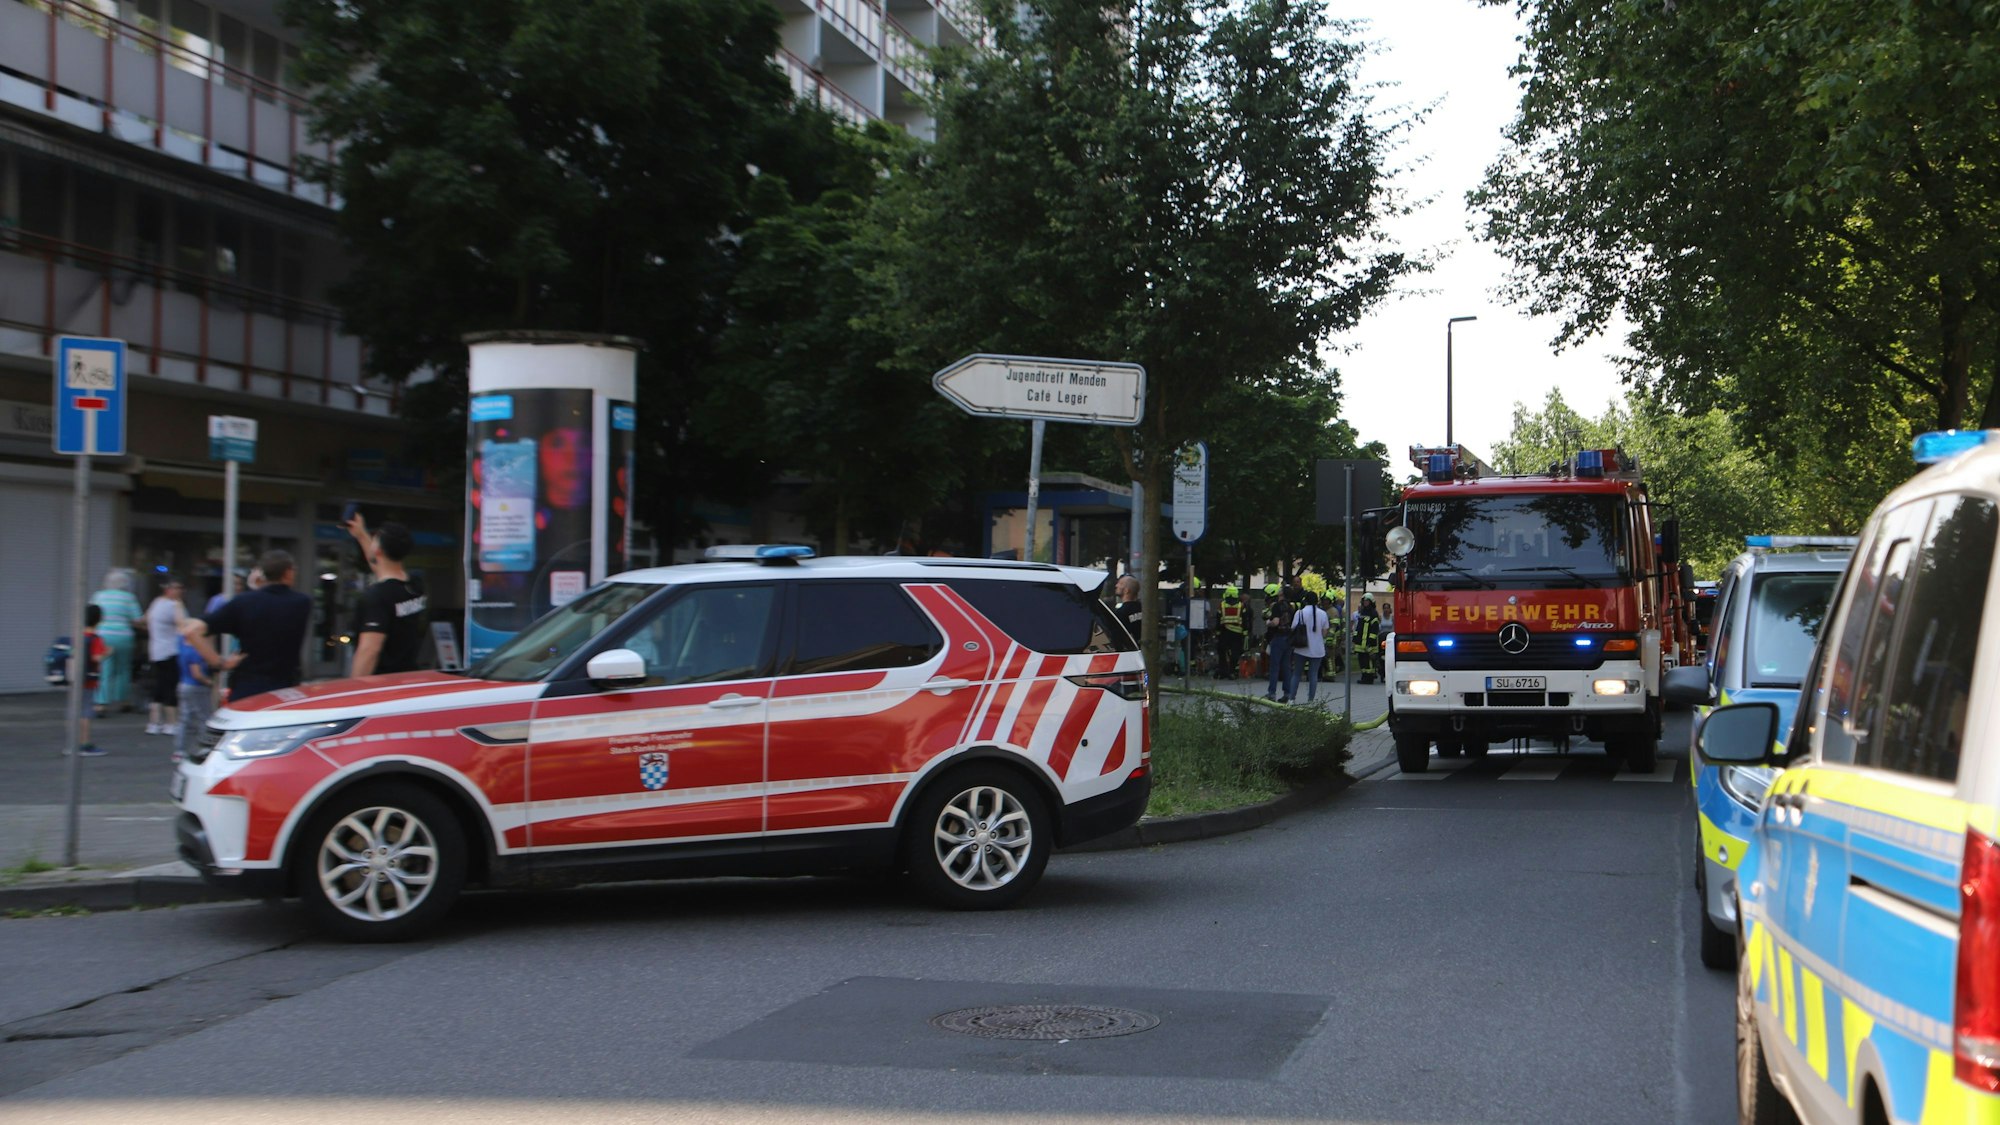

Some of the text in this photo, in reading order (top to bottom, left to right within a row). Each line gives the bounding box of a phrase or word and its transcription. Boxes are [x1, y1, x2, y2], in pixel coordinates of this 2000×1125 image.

[1006, 368, 1107, 387] Jugendtreff Menden
[1430, 604, 1600, 621] FEUERWEHR
[1496, 679, 1540, 688] SU 6716
